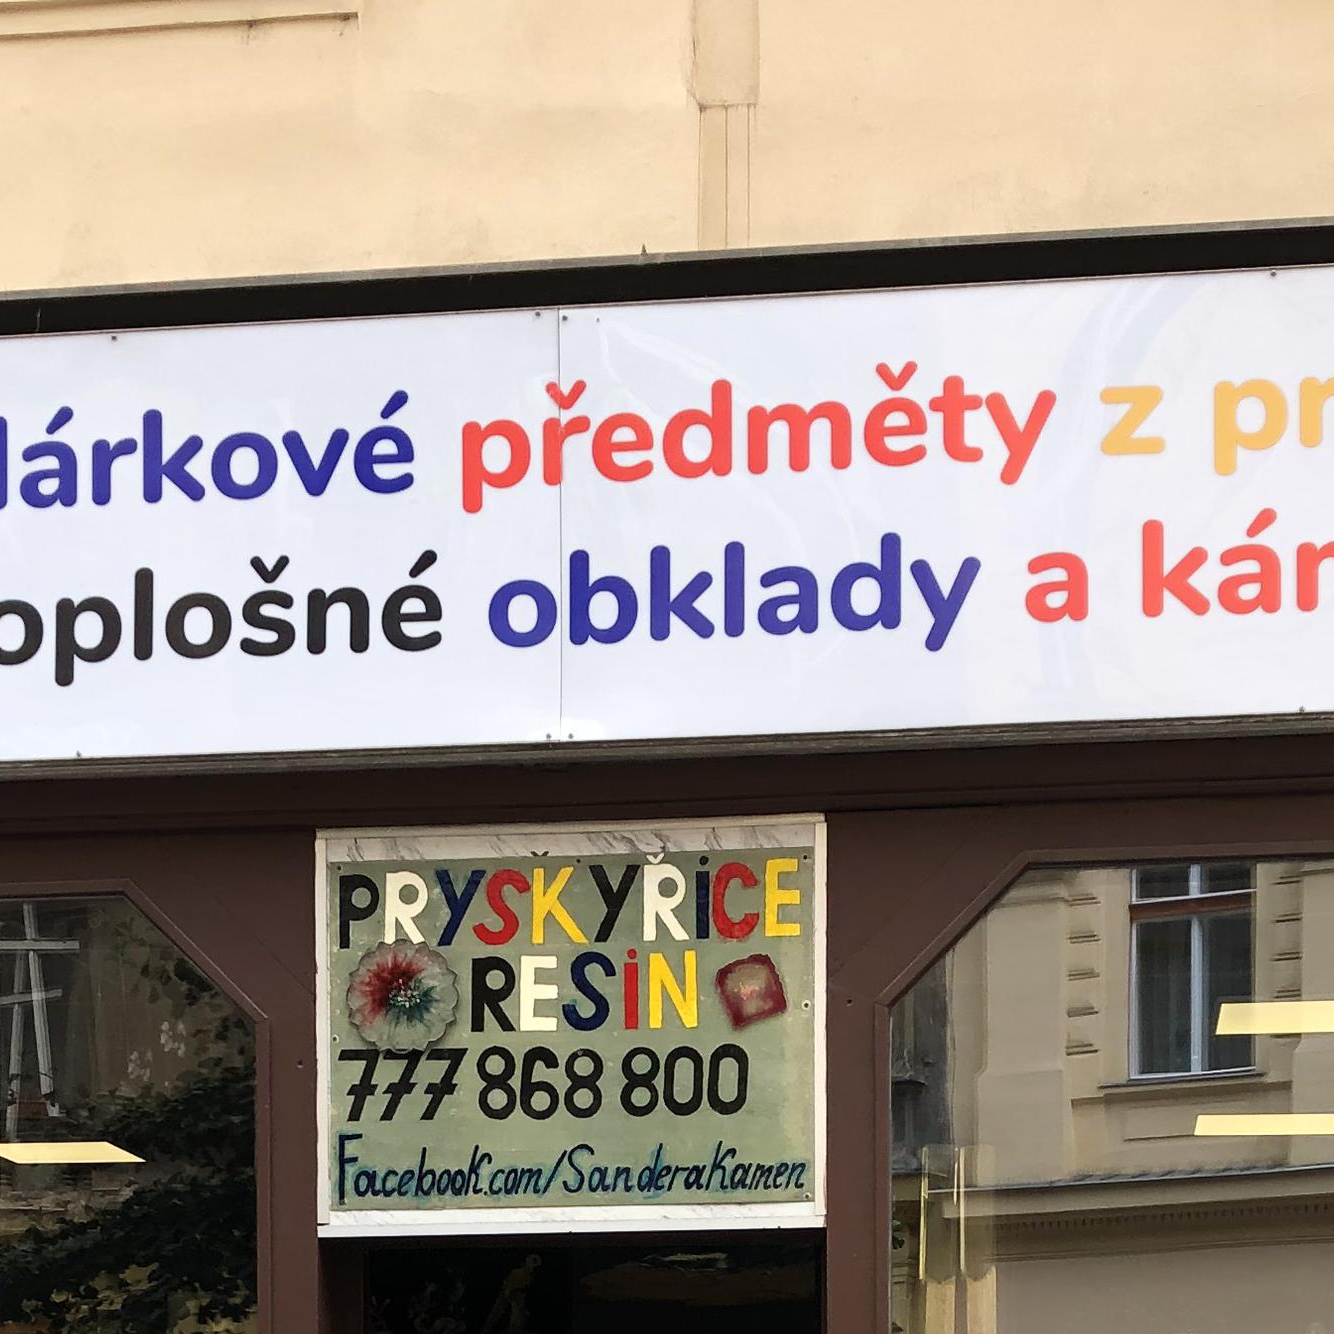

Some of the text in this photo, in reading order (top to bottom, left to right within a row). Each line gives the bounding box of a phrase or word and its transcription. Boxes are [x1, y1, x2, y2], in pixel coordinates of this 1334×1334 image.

[461, 362, 1056, 513] předměty
[1099, 384, 1167, 457] z
[487, 532, 981, 652] obklady
[1024, 551, 1088, 623] a
[337, 1043, 750, 1122] 777 868 800
